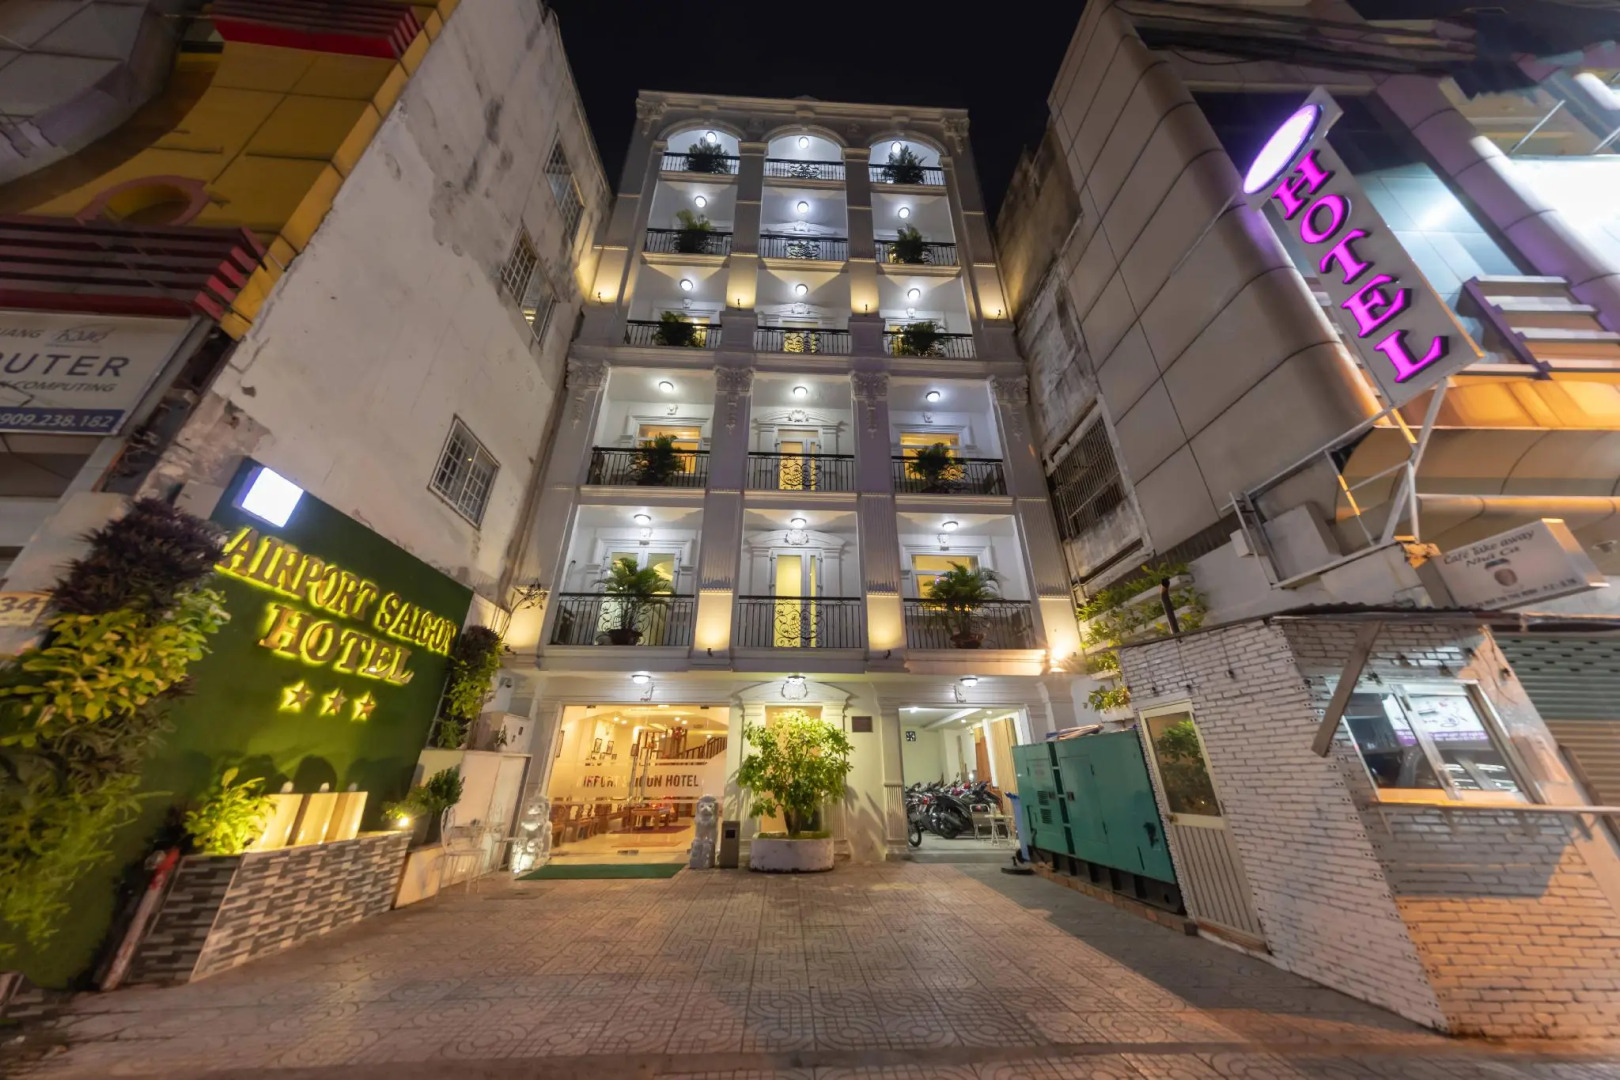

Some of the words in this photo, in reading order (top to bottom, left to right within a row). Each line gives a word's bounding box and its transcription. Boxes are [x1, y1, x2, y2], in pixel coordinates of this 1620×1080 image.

[1272, 149, 1445, 383] HOTEL
[0, 352, 130, 377] UTER
[214, 526, 379, 621] AIRPORT
[374, 592, 460, 656] SAIGON
[258, 602, 414, 685] HOTEL
[665, 774, 699, 787] HOTEL
